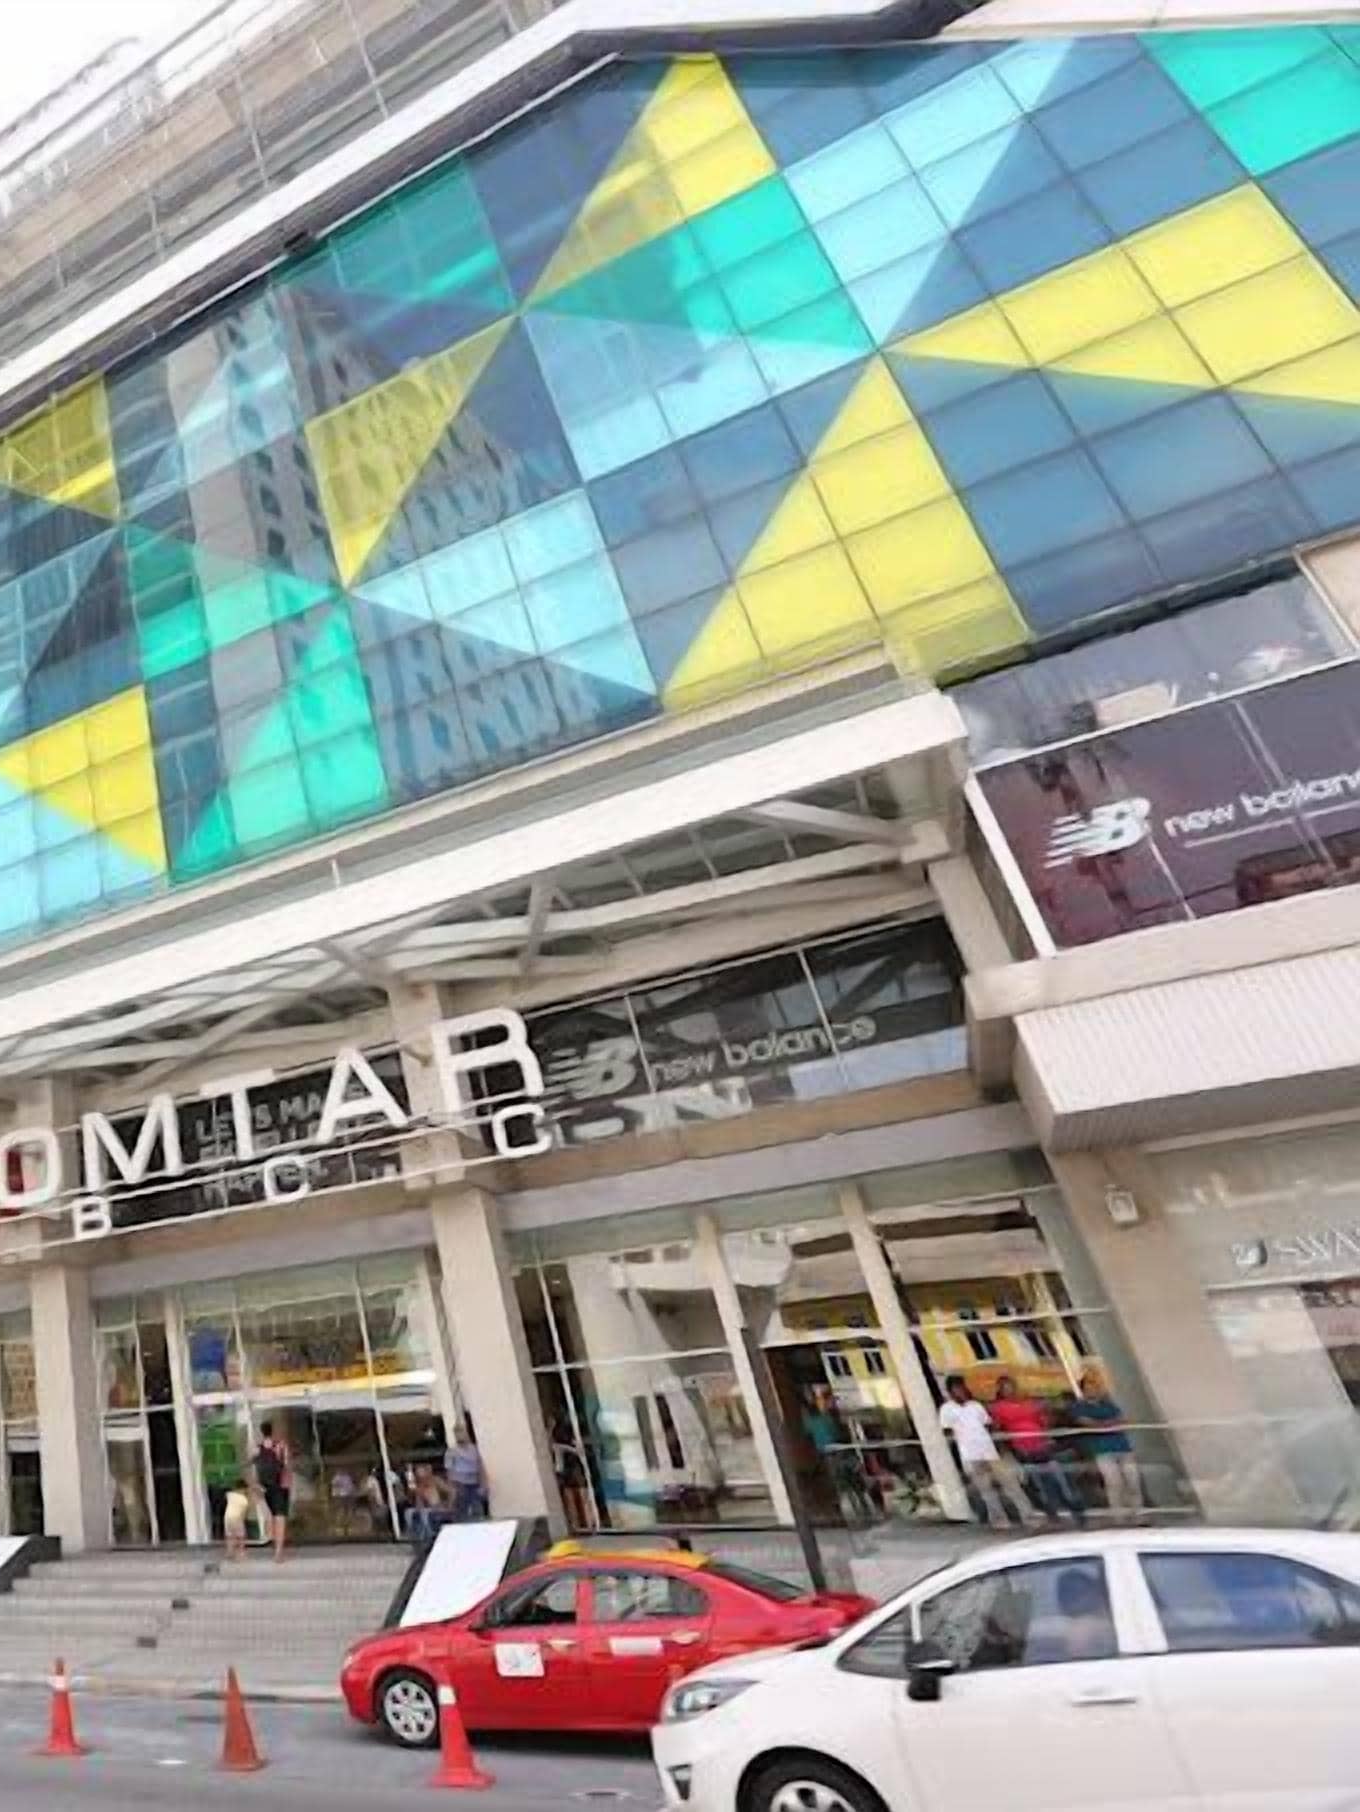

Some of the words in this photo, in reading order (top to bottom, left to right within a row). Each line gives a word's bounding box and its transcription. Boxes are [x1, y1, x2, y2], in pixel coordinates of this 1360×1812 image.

[1164, 803, 1235, 837] new
[650, 1050, 716, 1084] new
[721, 1015, 878, 1068] balance
